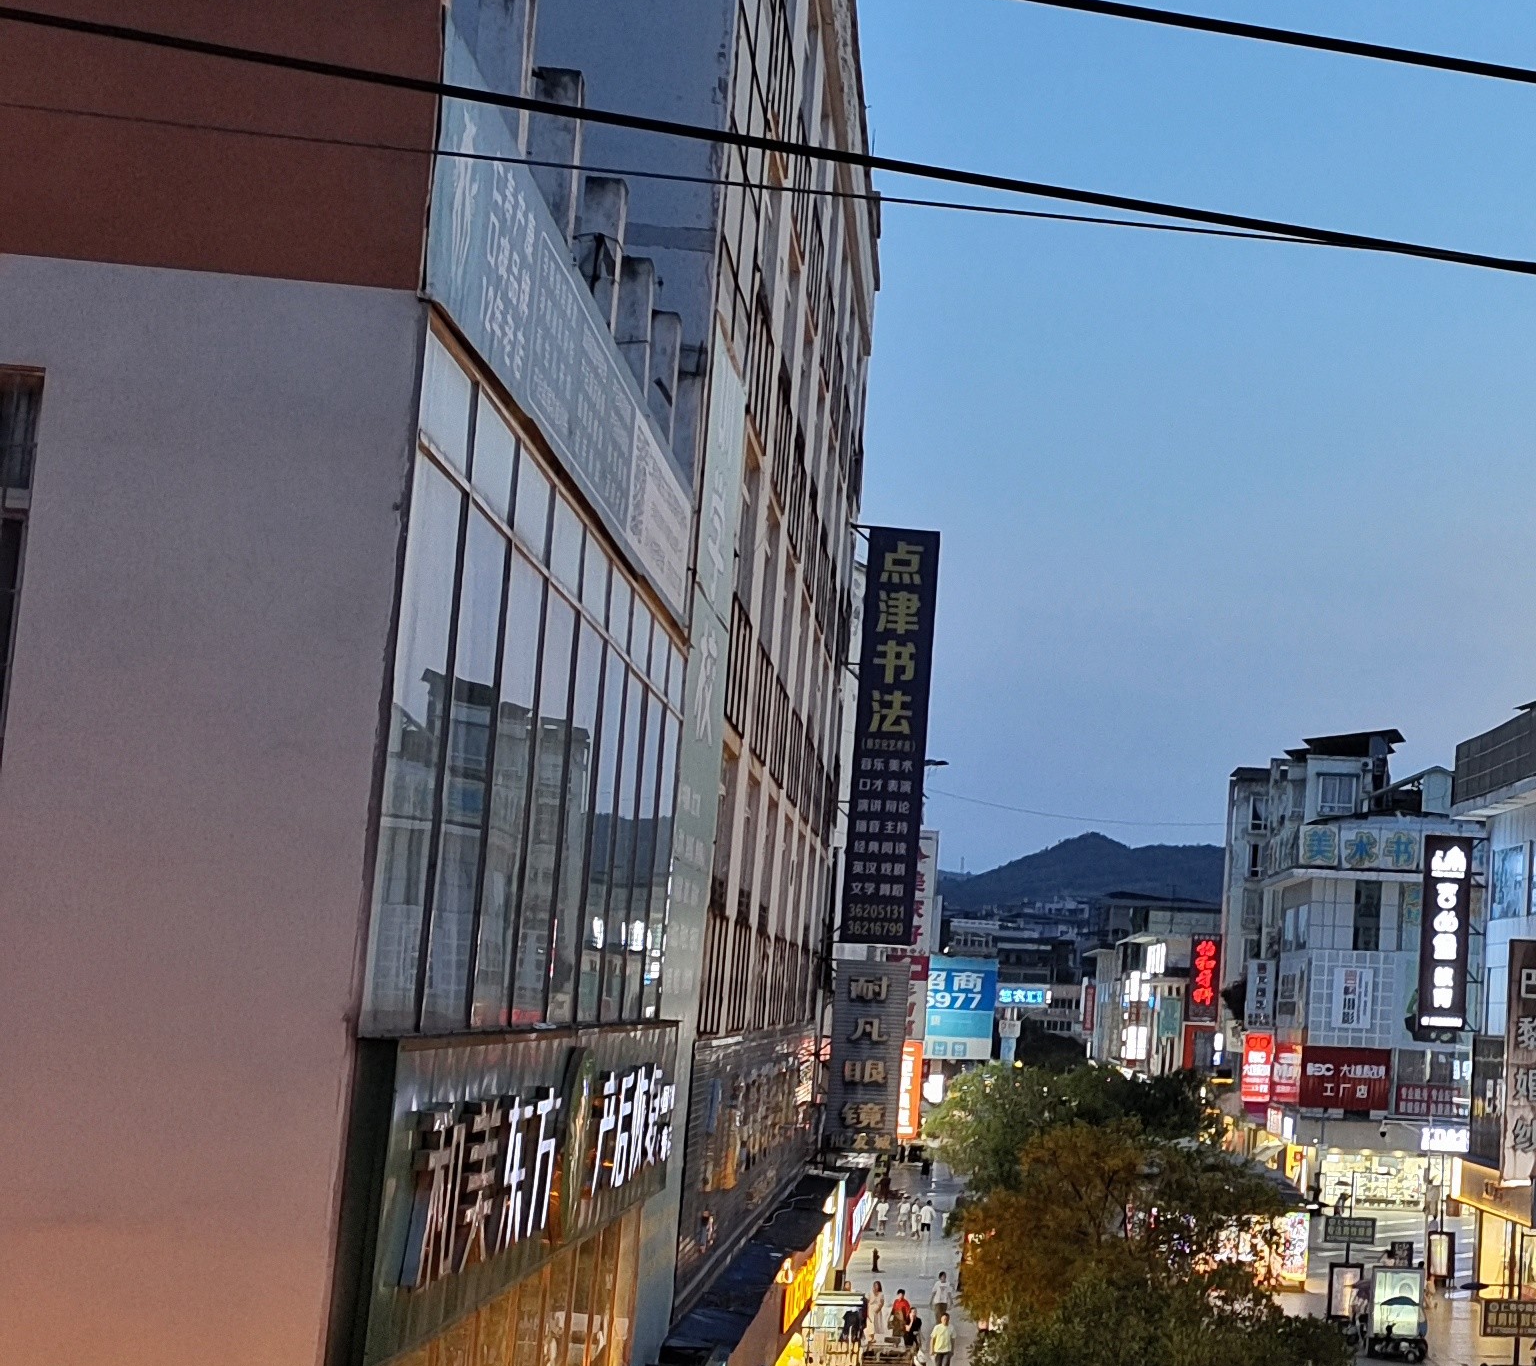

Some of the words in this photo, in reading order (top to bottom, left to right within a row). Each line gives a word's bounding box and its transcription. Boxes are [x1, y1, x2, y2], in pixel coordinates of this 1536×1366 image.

[867, 541, 925, 735] 点津书法
[860, 757, 885, 772] 音乐
[888, 758, 913, 773] 美术
[858, 778, 884, 792] 口才
[857, 799, 882, 813] 演讲
[883, 820, 909, 836] 主持
[851, 882, 876, 895] 文学
[849, 903, 904, 920] 36205131
[848, 920, 904, 936] 36216799
[842, 975, 892, 1129] 耐凡眼镜
